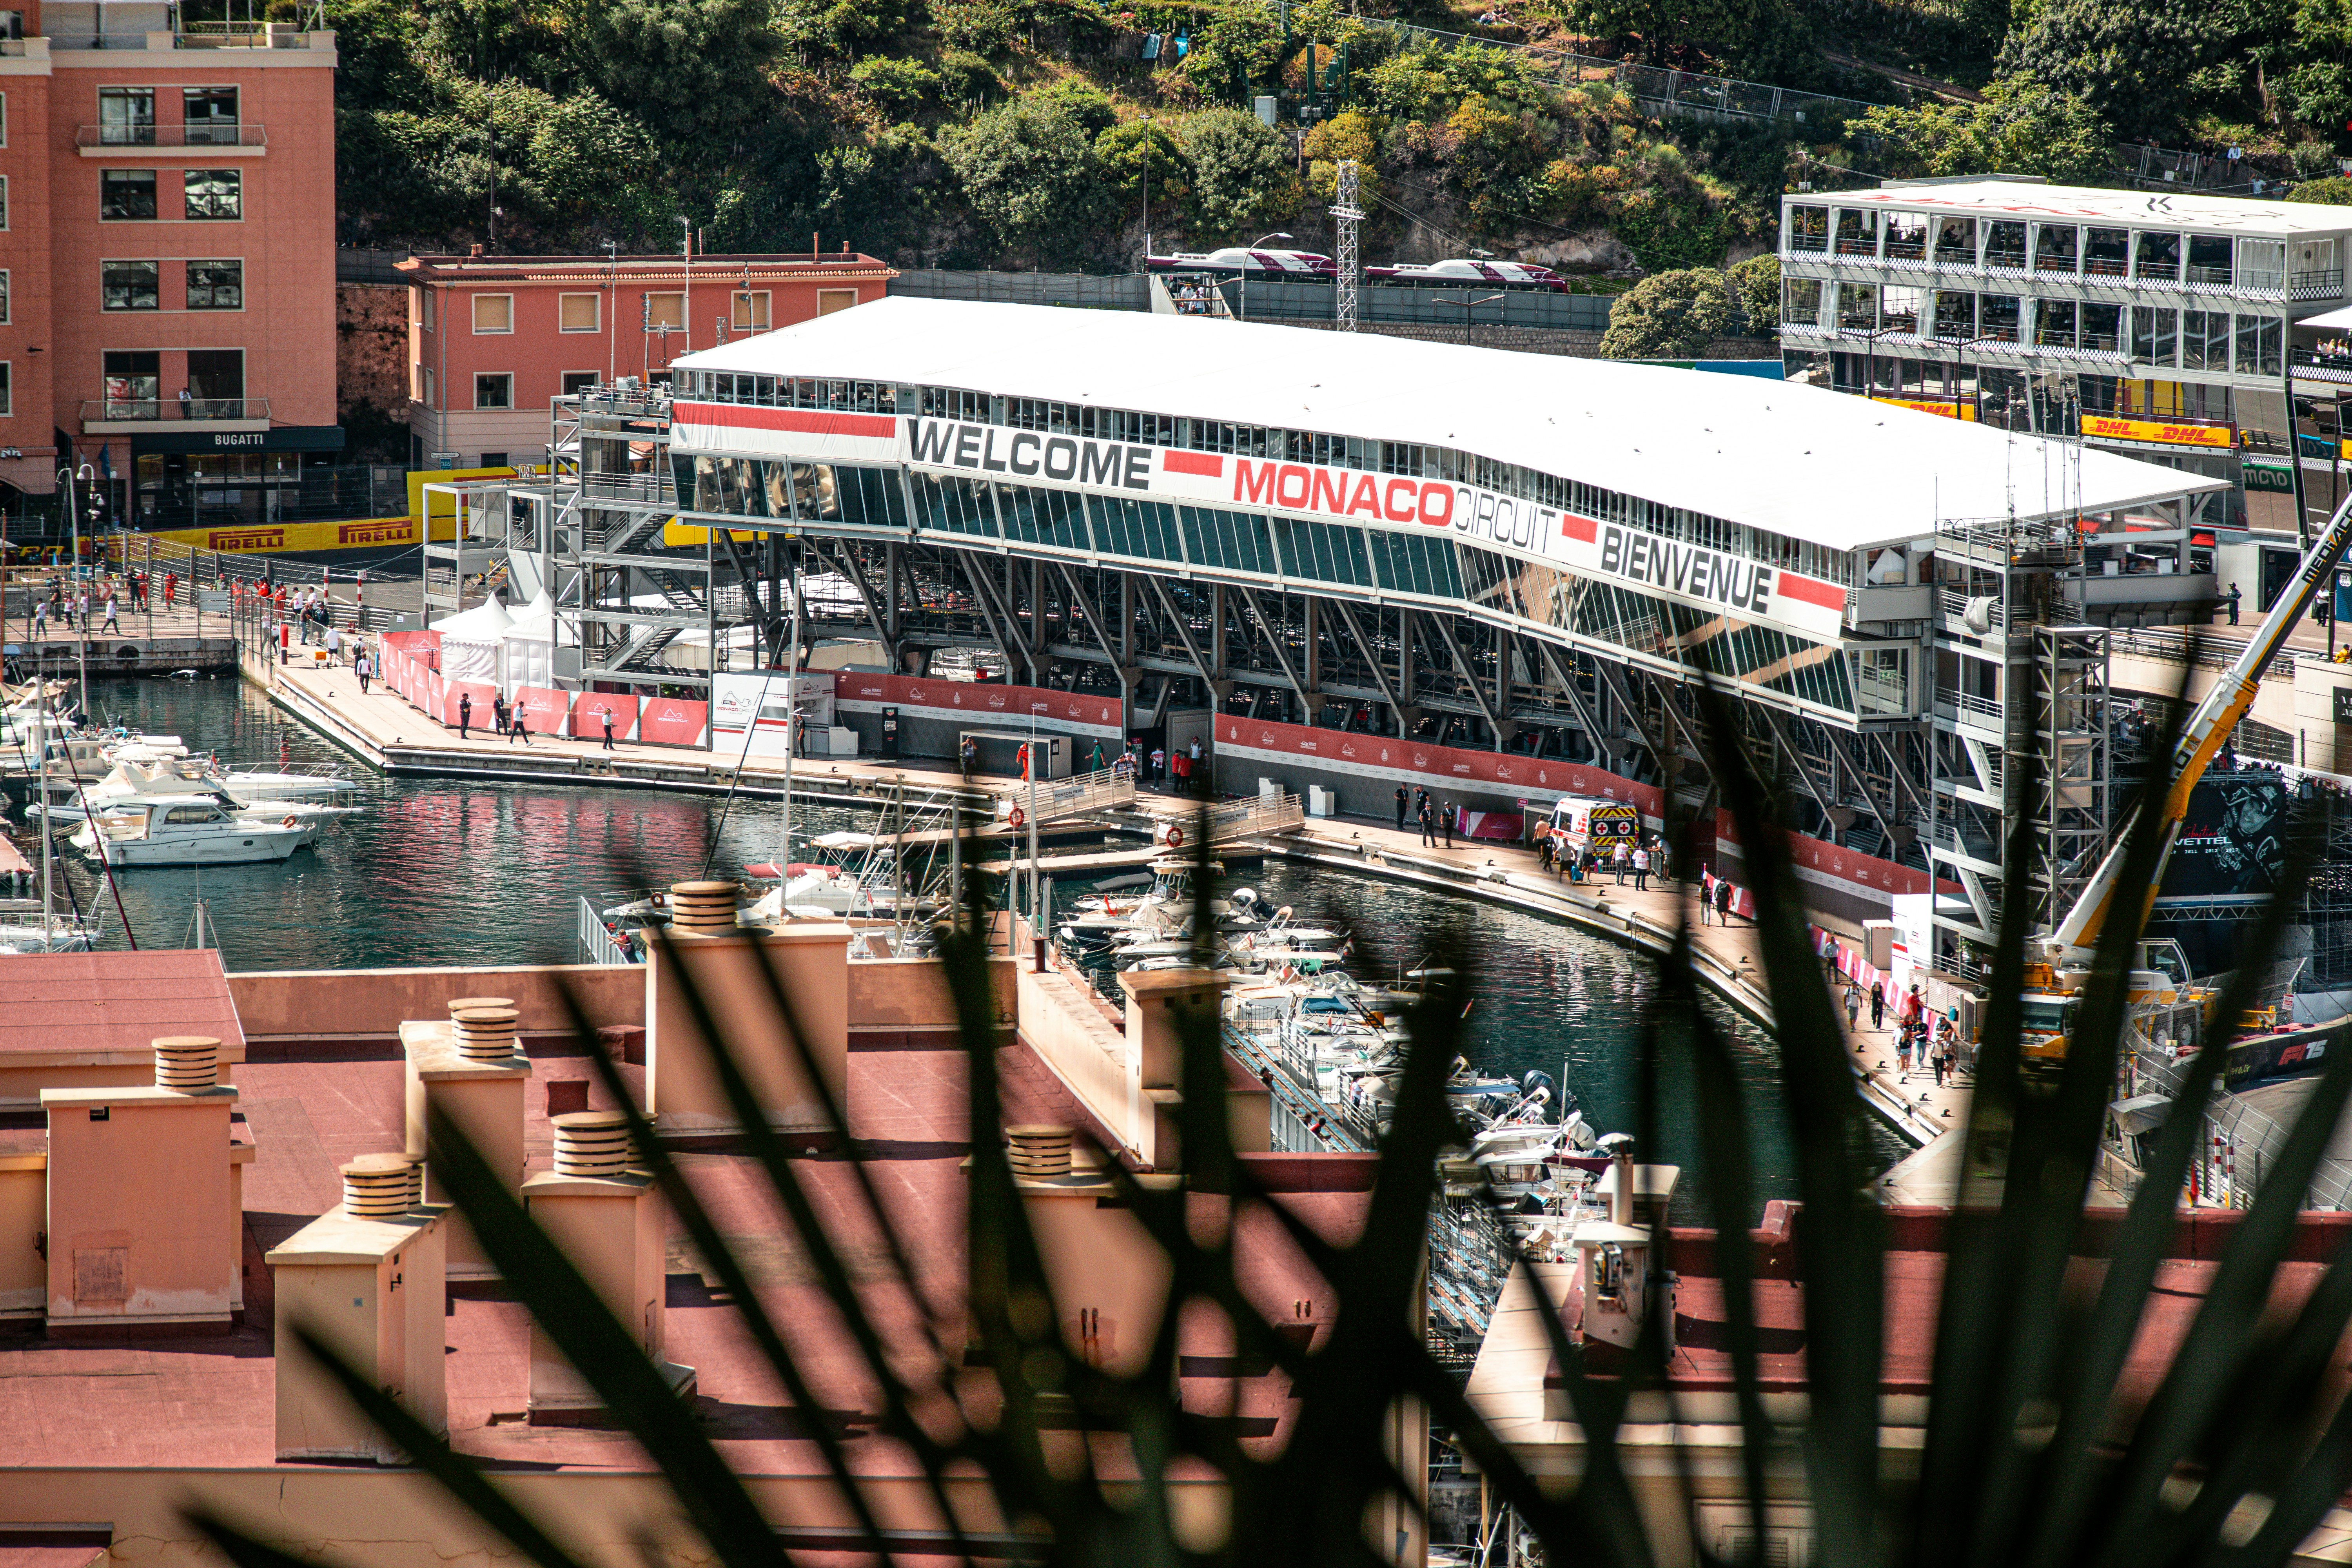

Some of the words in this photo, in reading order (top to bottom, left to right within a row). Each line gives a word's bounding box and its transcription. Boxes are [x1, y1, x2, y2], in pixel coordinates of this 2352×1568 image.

[1910, 404, 1953, 418] DHL
[2095, 420, 2132, 436] DHL
[2162, 426, 2209, 443] DHL
[215, 434, 263, 445] BUGATTI
[907, 418, 1152, 490] WELCOME
[1233, 459, 1455, 527] MONACO
[1455, 488, 1556, 554] CIRCUIT
[1601, 525, 1772, 615] BIENVENUE
[209, 528, 284, 550] PIRELLI
[339, 520, 412, 544] PIRELLI
[2174, 837, 2232, 846] VETTEL
